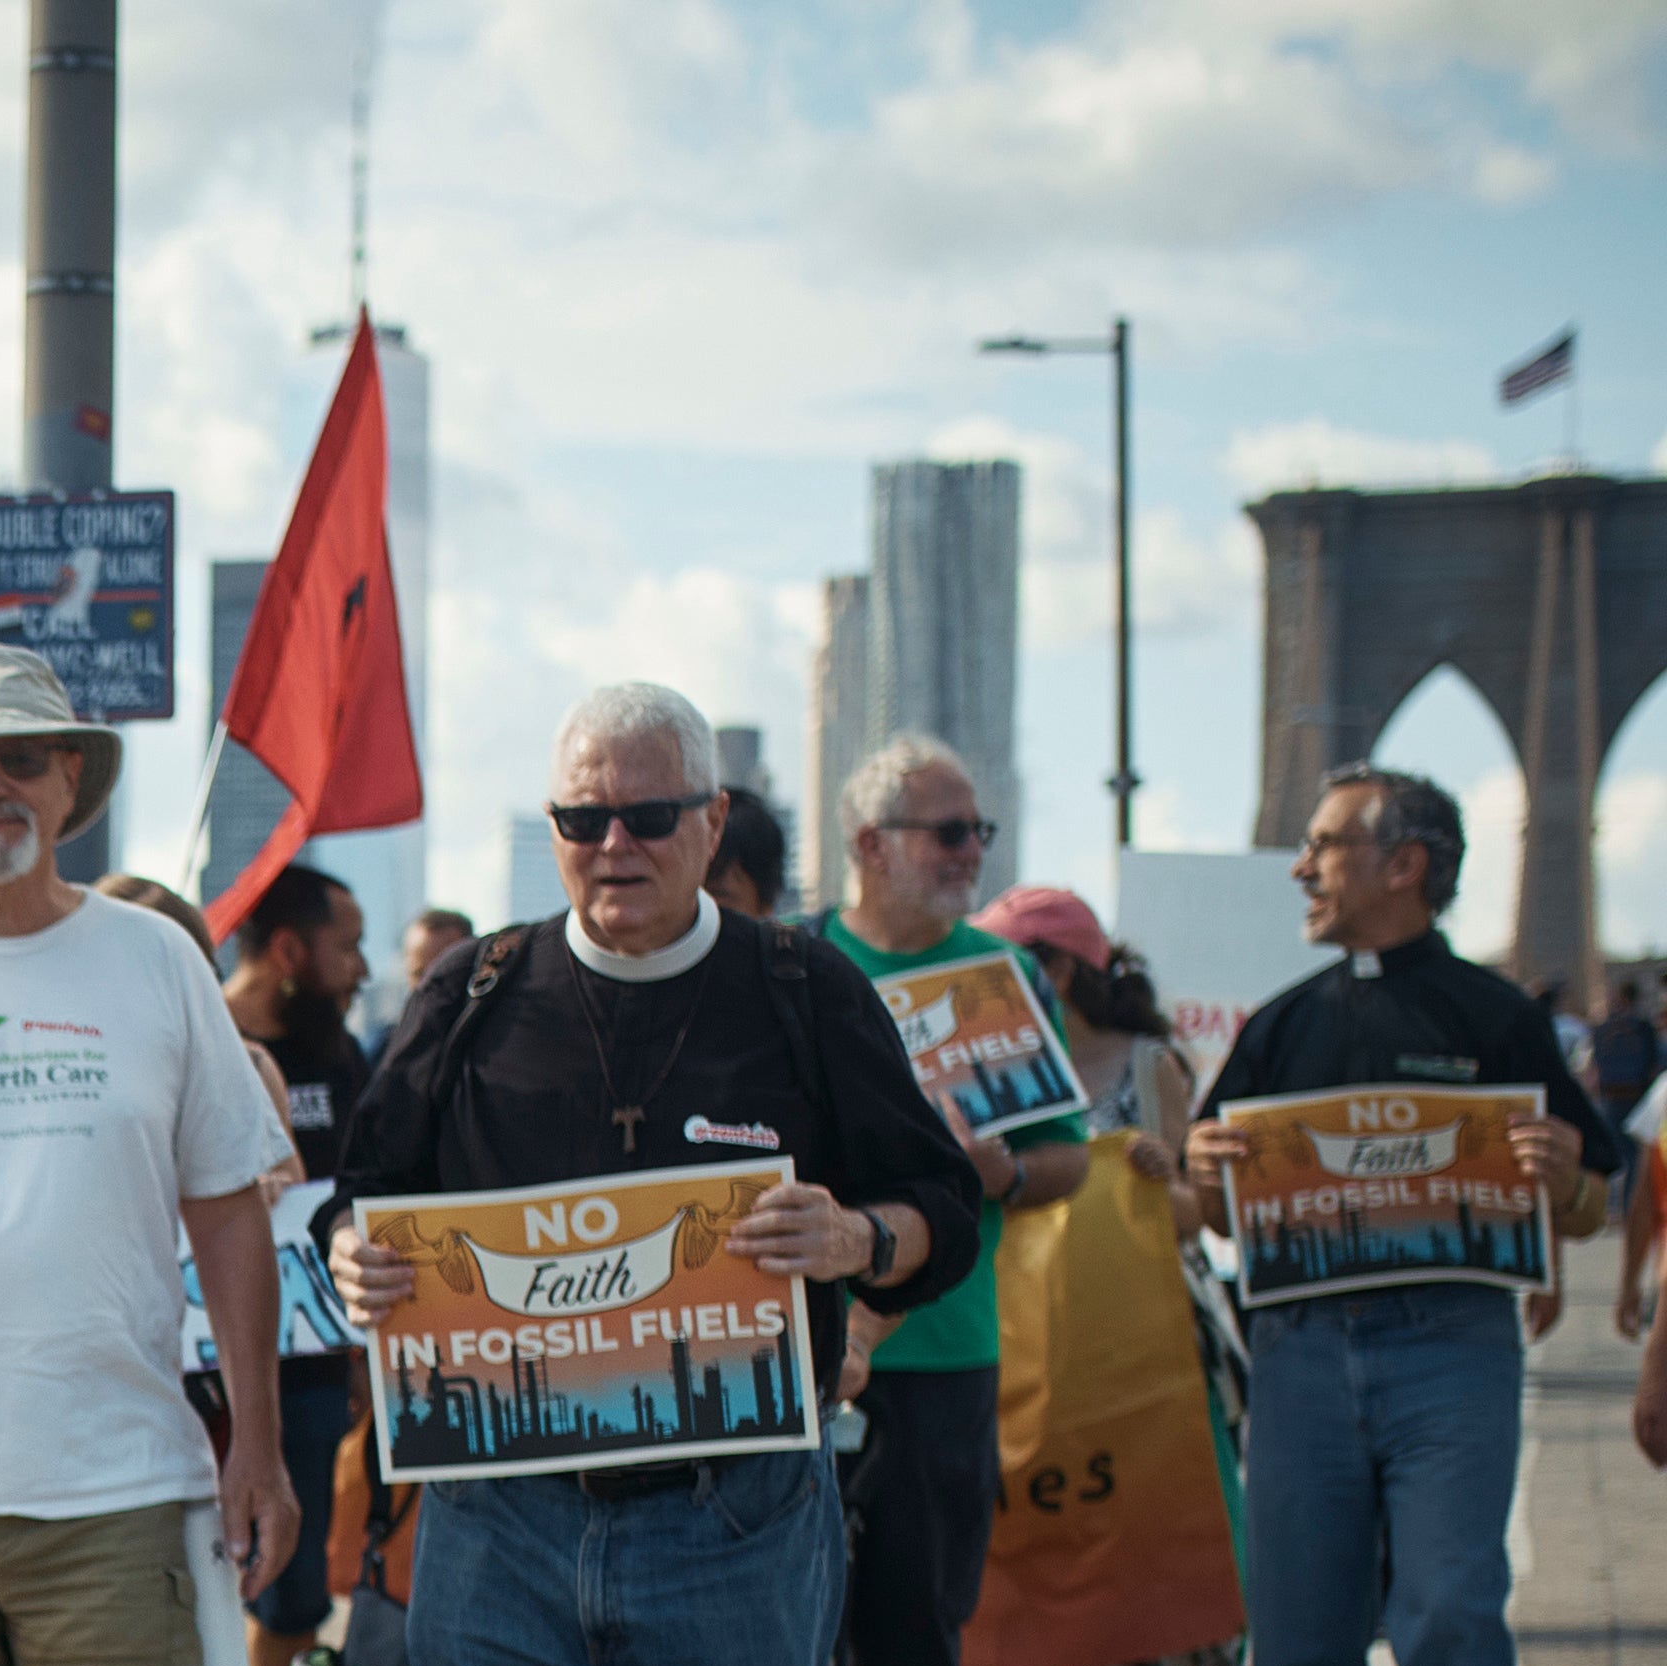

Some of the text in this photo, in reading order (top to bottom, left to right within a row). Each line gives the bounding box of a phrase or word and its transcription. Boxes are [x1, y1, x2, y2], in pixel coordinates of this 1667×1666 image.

[938, 1025, 1042, 1073] FUELS
[46, 1062, 109, 1086] Care
[1349, 1099, 1418, 1130] NO
[1349, 1136, 1433, 1172] Faith
[524, 1196, 619, 1249] NO
[1245, 1177, 1534, 1227] IN FOSSIL FUELS
[525, 1250, 637, 1310] Faith
[388, 1301, 786, 1369] IN FOSSIL FUELS
